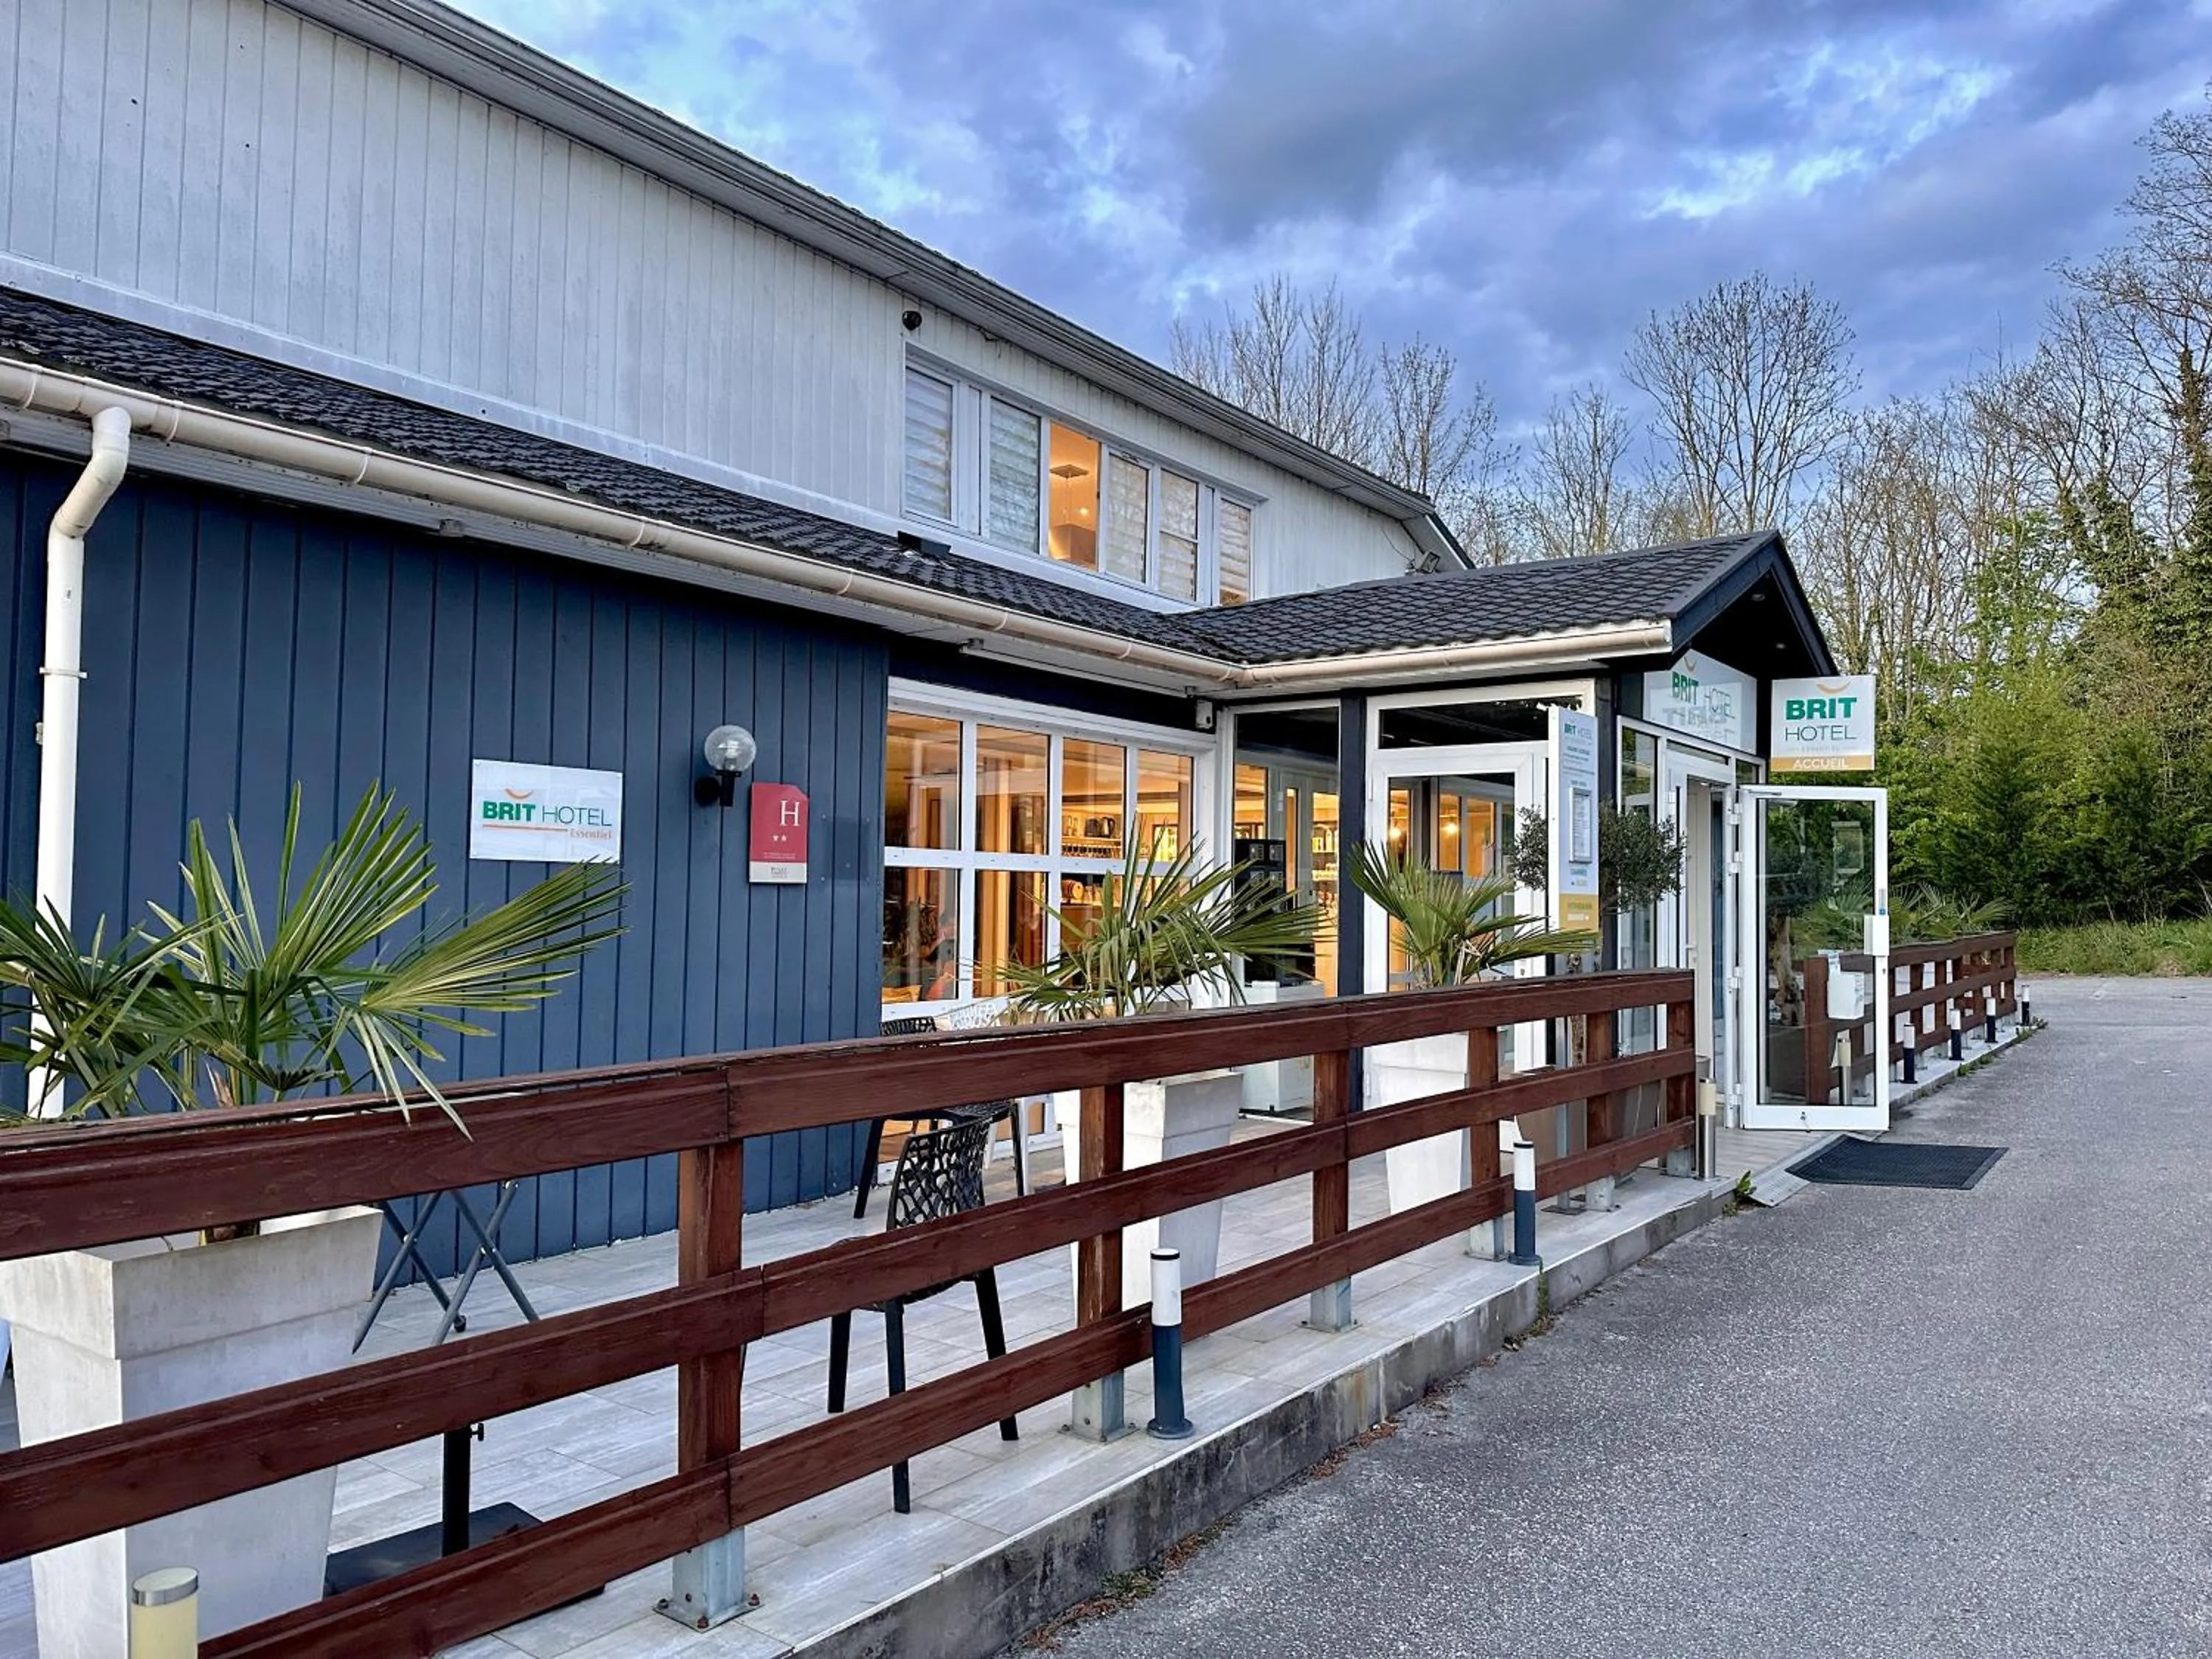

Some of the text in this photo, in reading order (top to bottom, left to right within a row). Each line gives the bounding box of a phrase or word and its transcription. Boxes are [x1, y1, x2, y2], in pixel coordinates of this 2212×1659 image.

[1672, 671, 1700, 705] BRIT
[1704, 686, 1736, 719] HOTEL
[1786, 697, 1857, 720] BRIT
[1785, 725, 1857, 741] HOTEL
[1793, 757, 1849, 769] ACCUEIL
[483, 801, 613, 827] BRIT HOTEL
[779, 800, 800, 826] H
